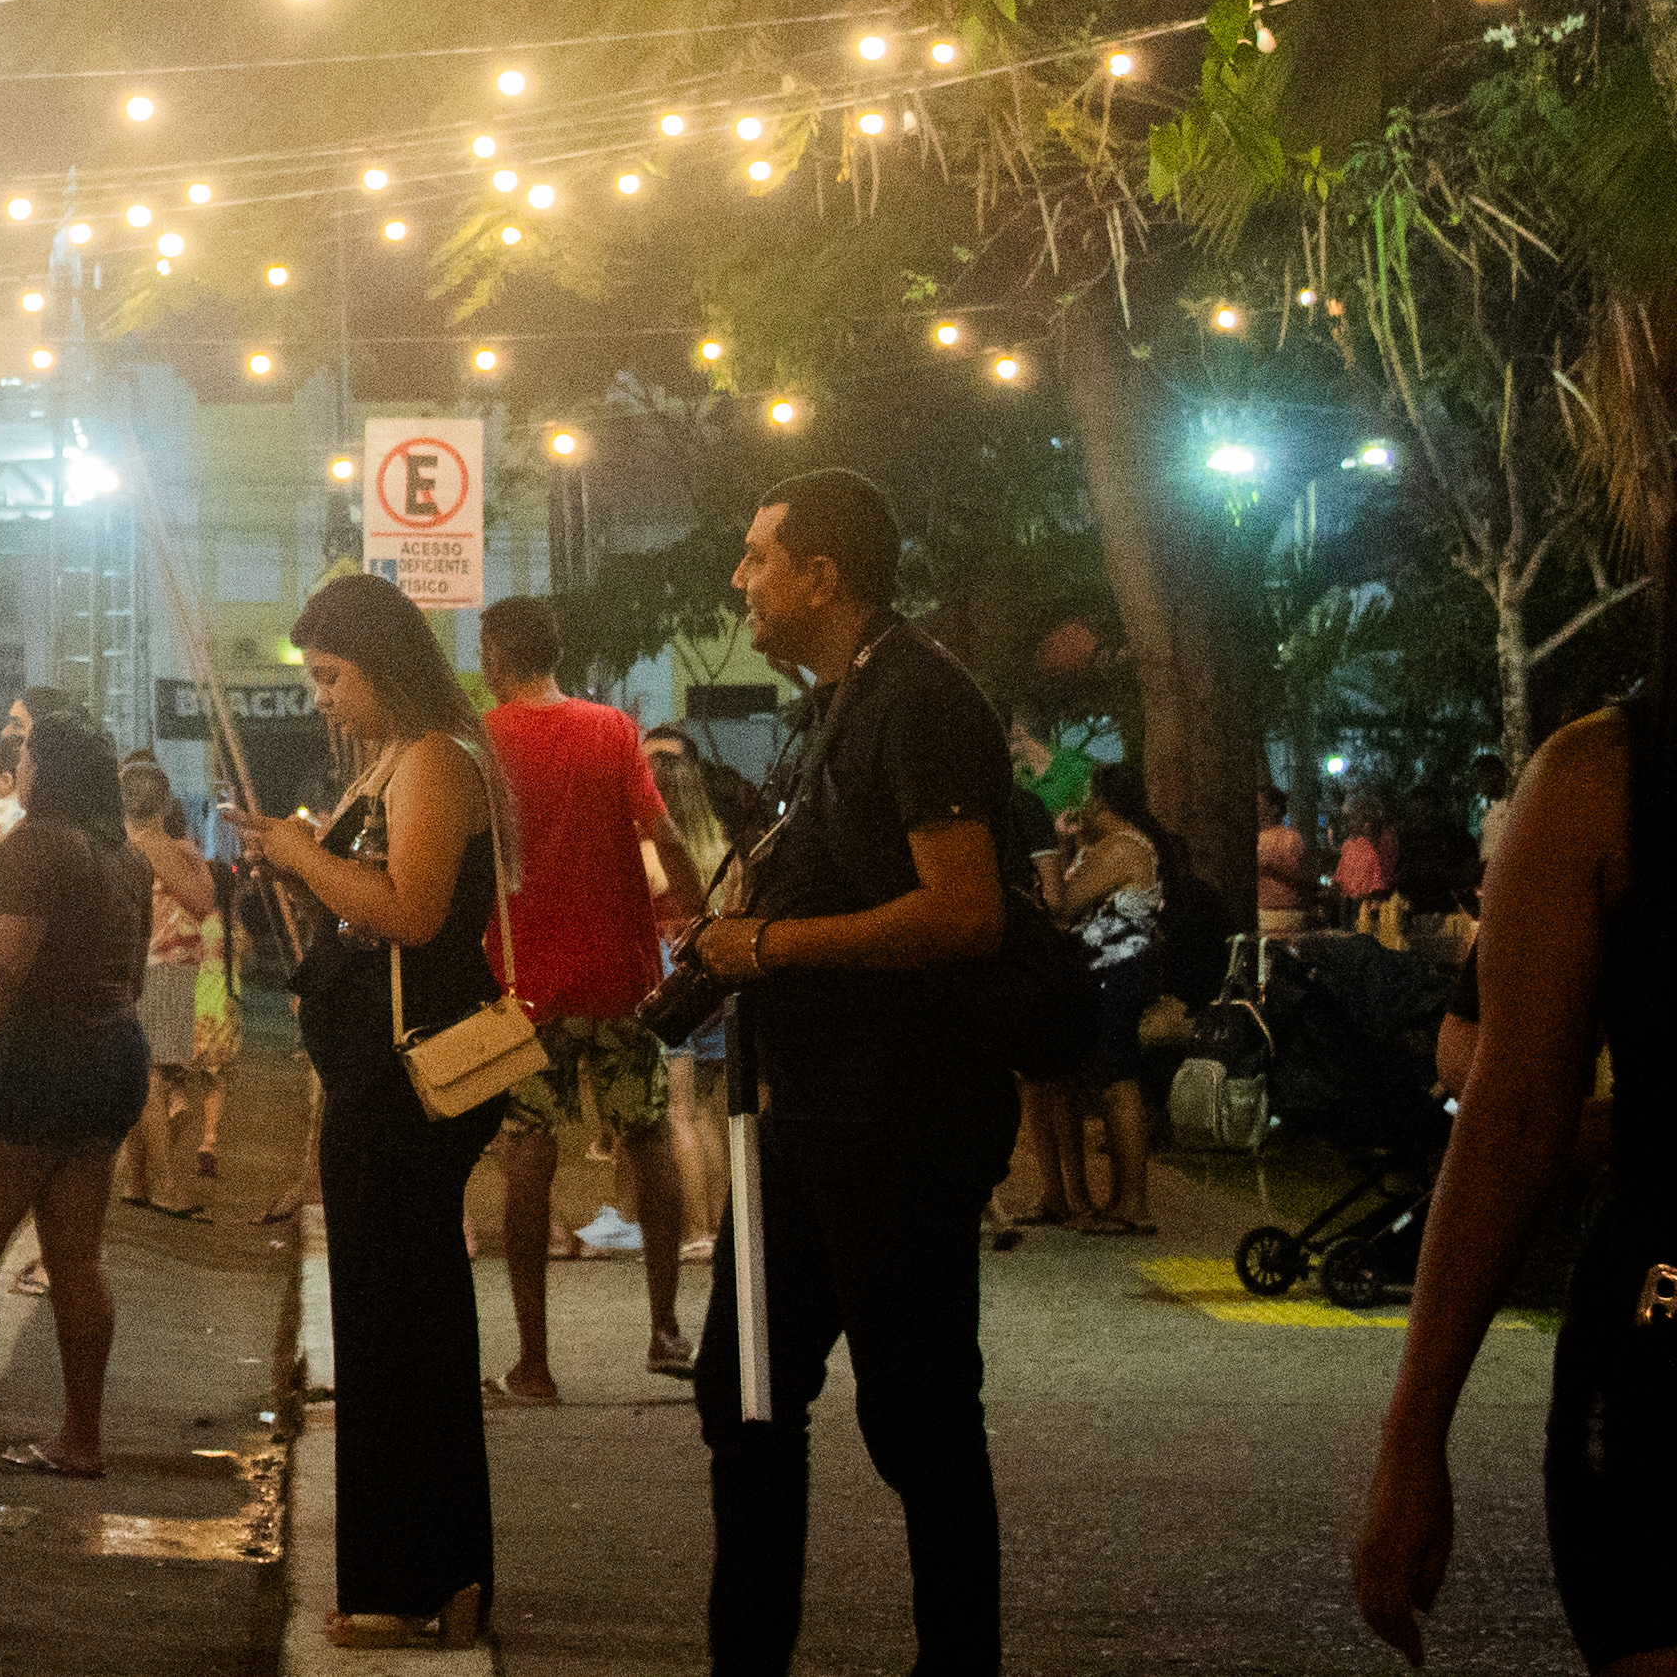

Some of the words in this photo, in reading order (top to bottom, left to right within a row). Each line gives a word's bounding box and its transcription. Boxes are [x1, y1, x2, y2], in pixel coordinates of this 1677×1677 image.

[406, 455, 438, 515] E
[401, 542, 462, 556] ACESSO
[399, 559, 469, 574] DEFICIENTE
